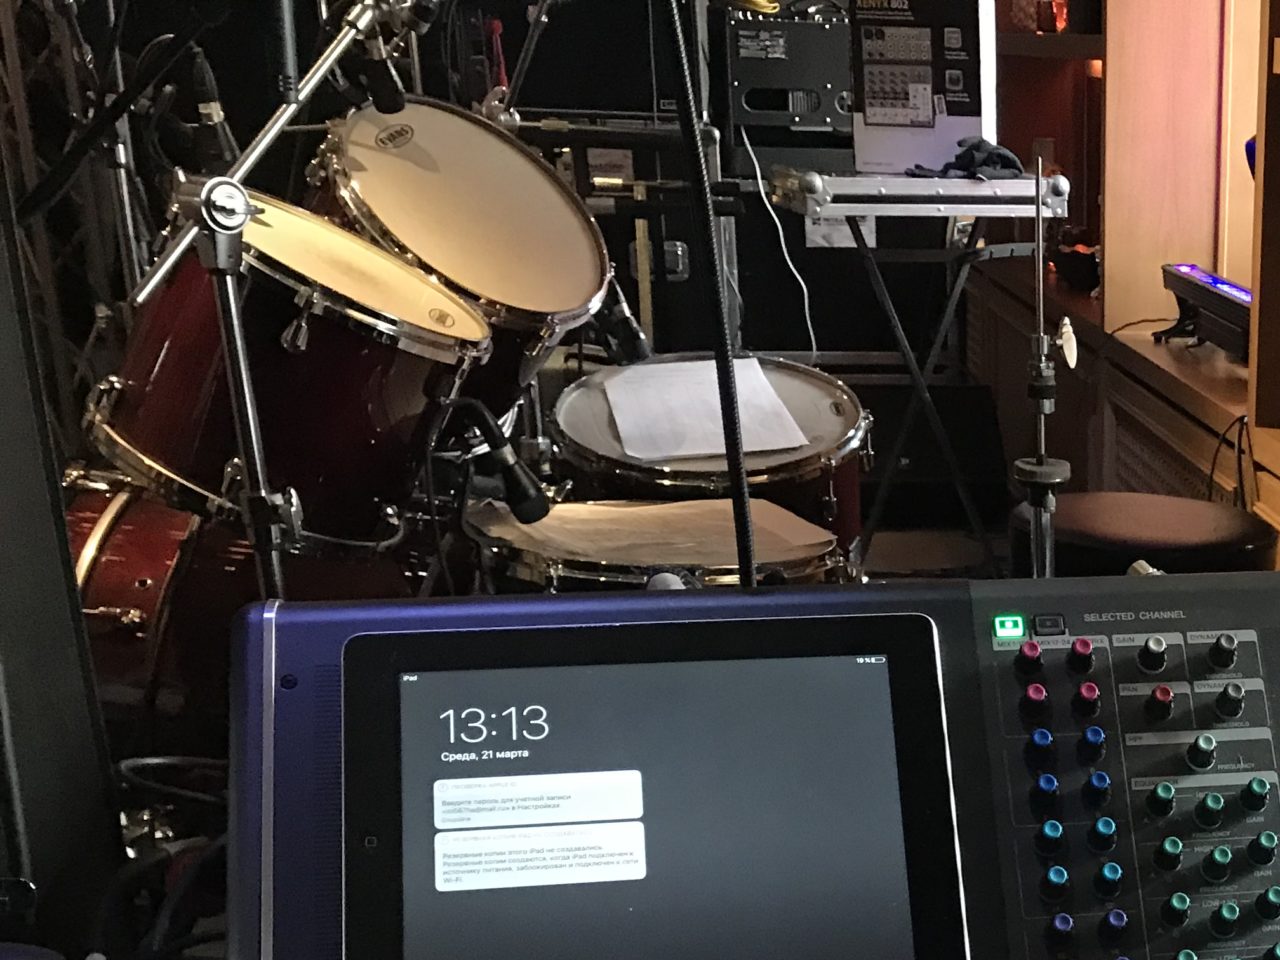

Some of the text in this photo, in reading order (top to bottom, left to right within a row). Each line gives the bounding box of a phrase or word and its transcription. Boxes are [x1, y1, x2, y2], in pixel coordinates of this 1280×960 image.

[1083, 610, 1187, 622] SELECTED CHANNEL
[403, 674, 418, 682] iPad
[439, 705, 550, 744] 13:13
[441, 750, 529, 762] Среда, 21 марта
